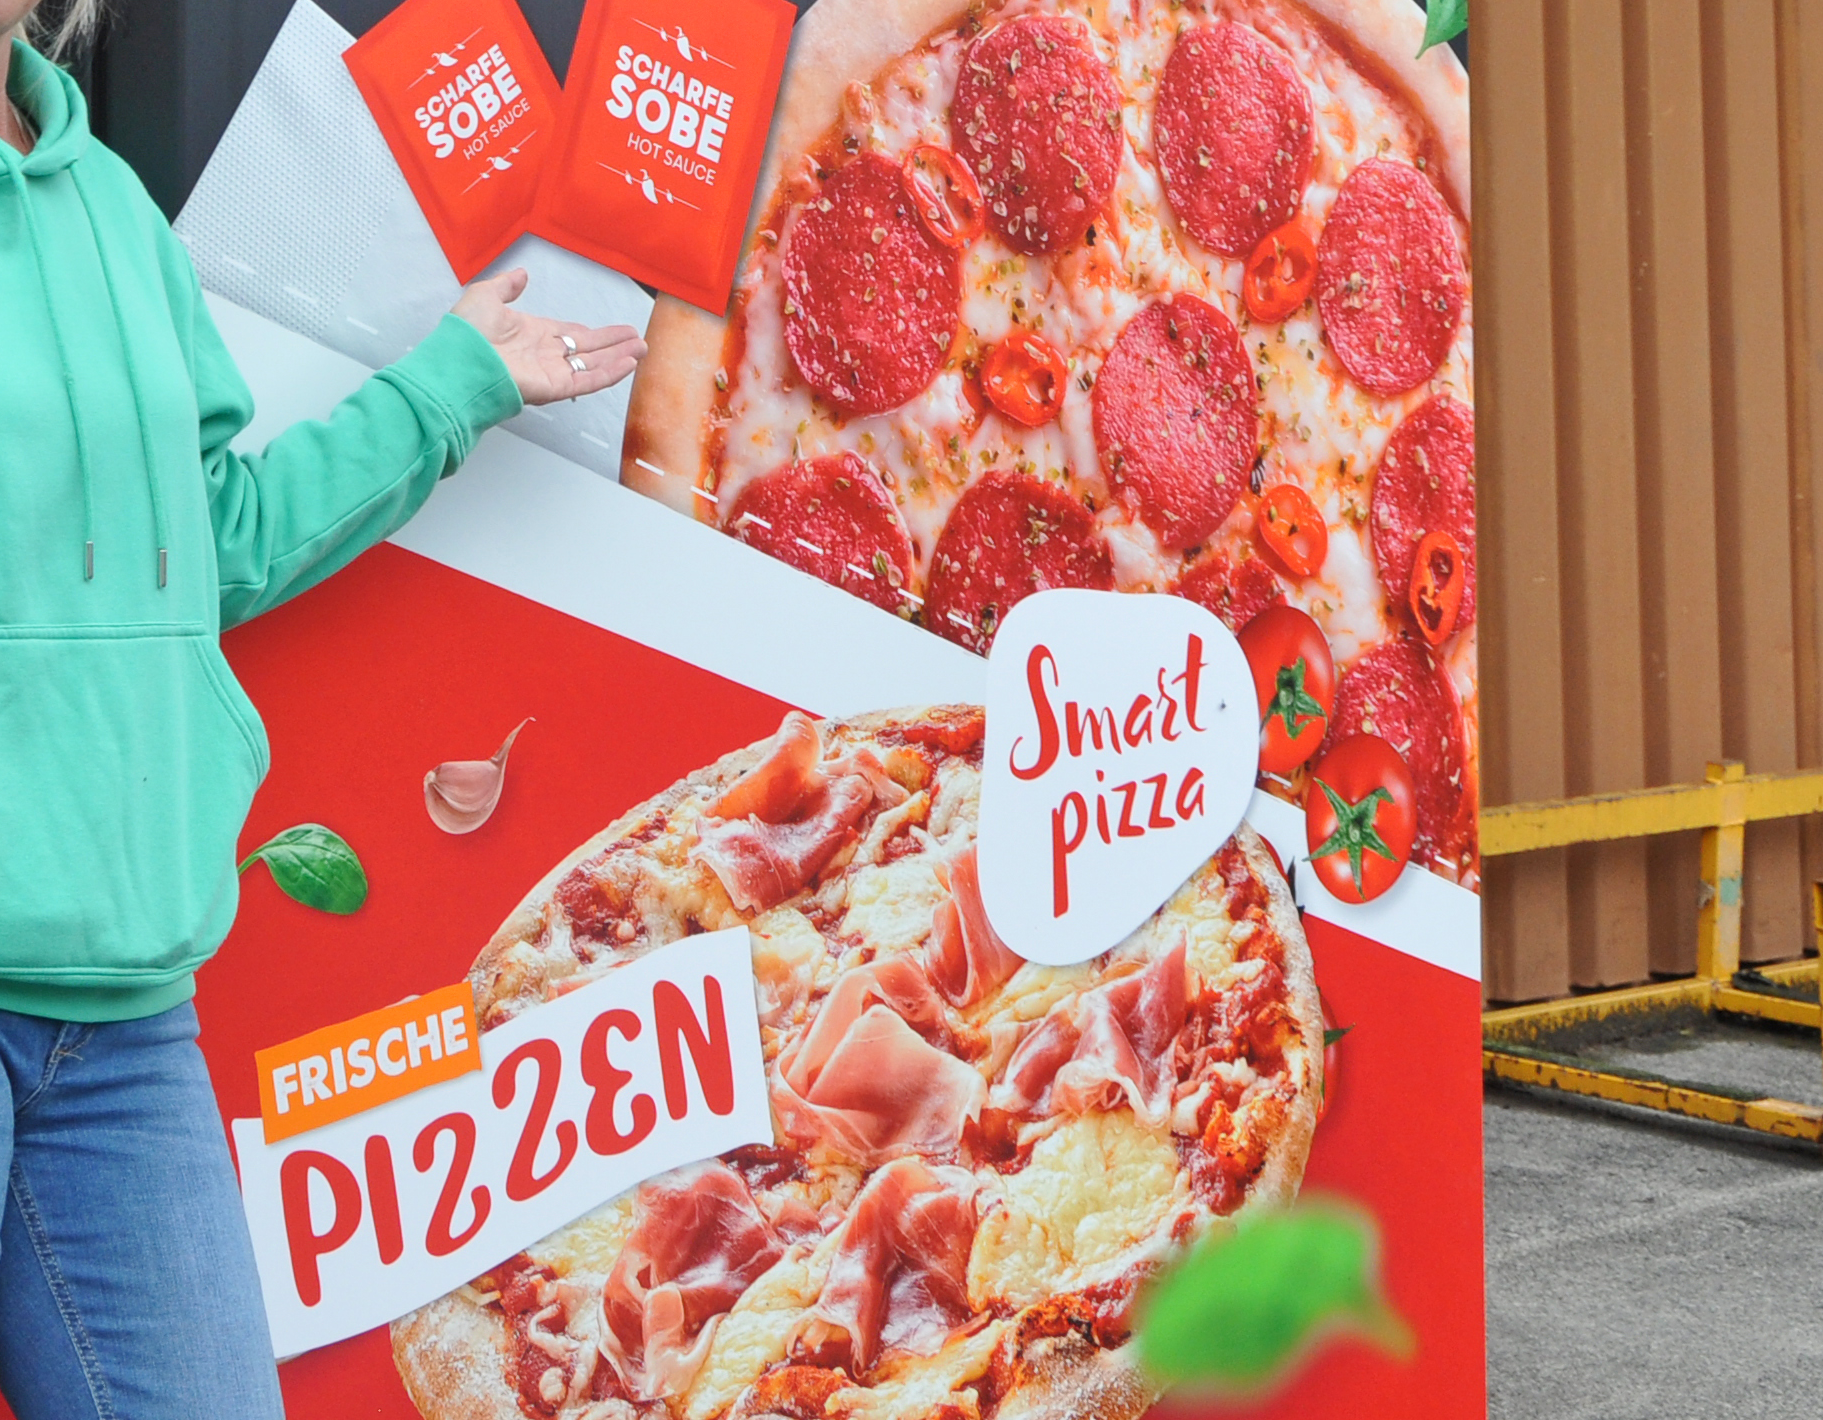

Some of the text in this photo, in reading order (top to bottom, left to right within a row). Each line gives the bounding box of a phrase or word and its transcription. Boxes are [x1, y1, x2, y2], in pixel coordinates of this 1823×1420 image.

[414, 42, 507, 129] SCHARFE
[462, 96, 532, 161] HOT SAUCE
[615, 44, 735, 120] SCHARFE
[626, 132, 717, 187] HOT SAUCE
[1008, 632, 1210, 781] Smart
[1050, 766, 1205, 919] pizza
[271, 1004, 470, 1115] FRISCHE
[278, 974, 736, 1308] PIZZEN
